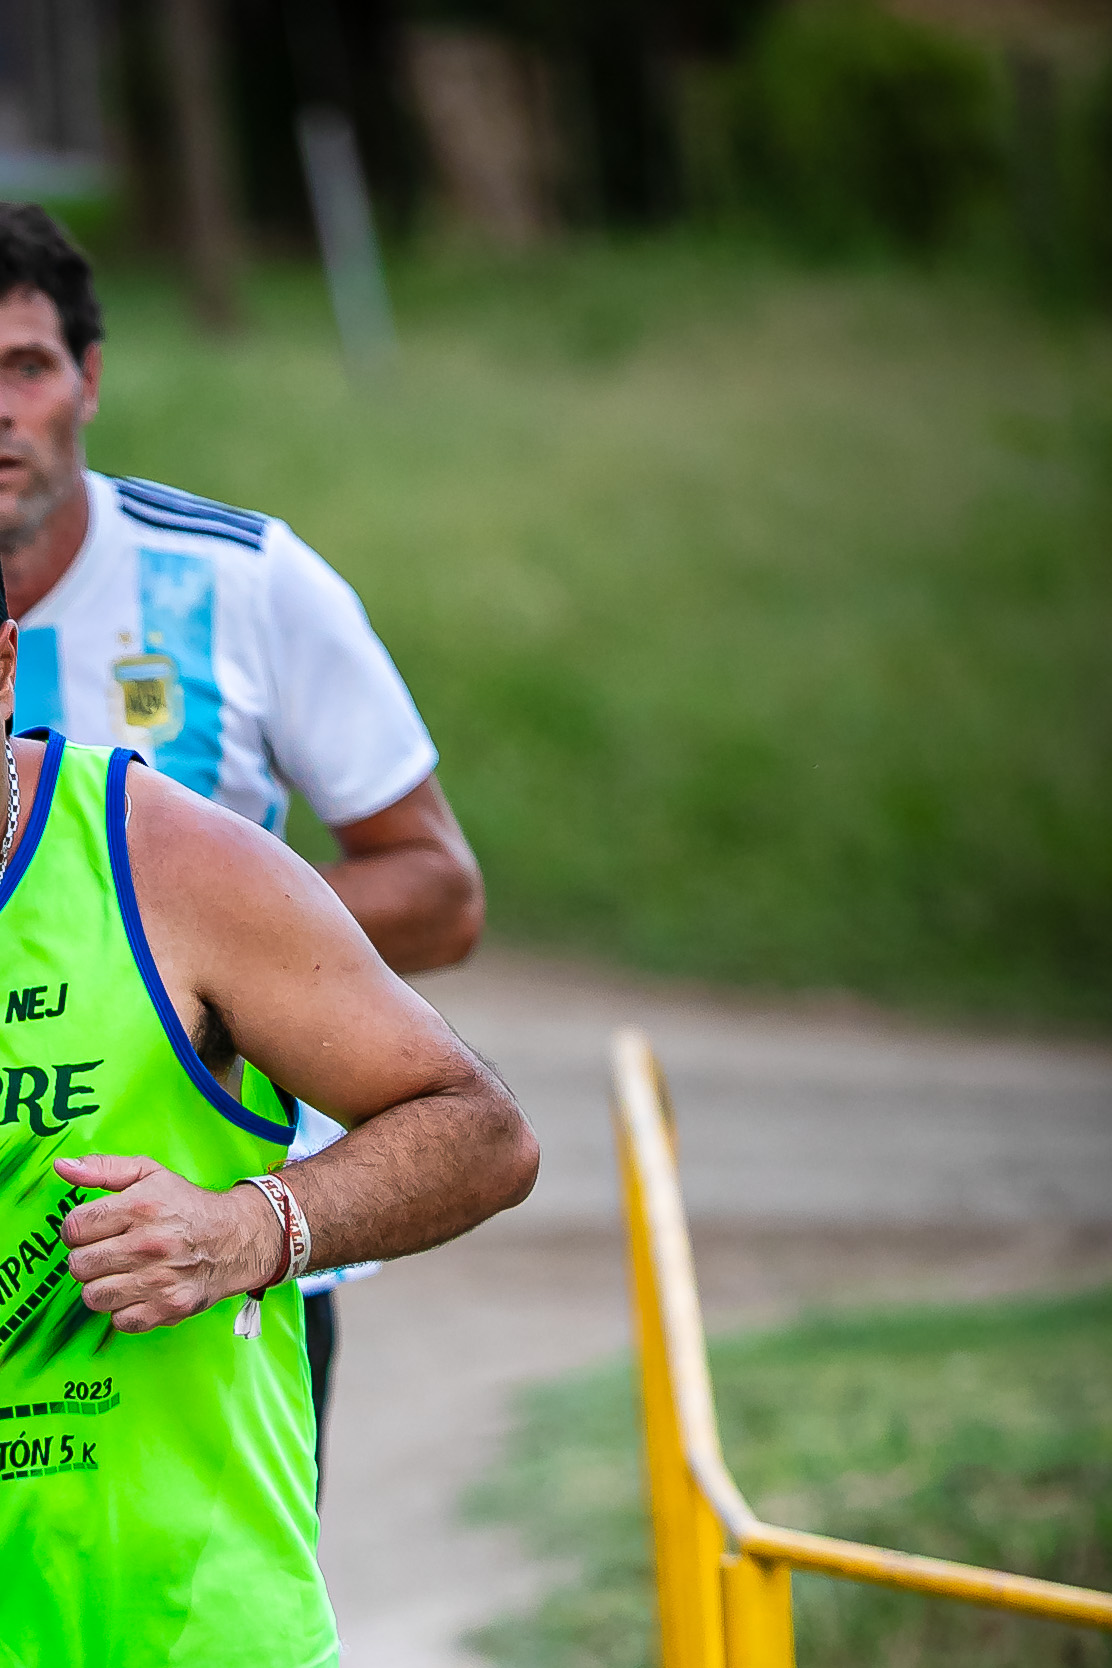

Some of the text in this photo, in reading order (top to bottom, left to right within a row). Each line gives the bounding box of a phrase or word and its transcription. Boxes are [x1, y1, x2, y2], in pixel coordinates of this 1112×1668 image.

[5, 983, 68, 1024] NEJ
[64, 1377, 113, 1400] 2023
[60, 1435, 75, 1464] 5
